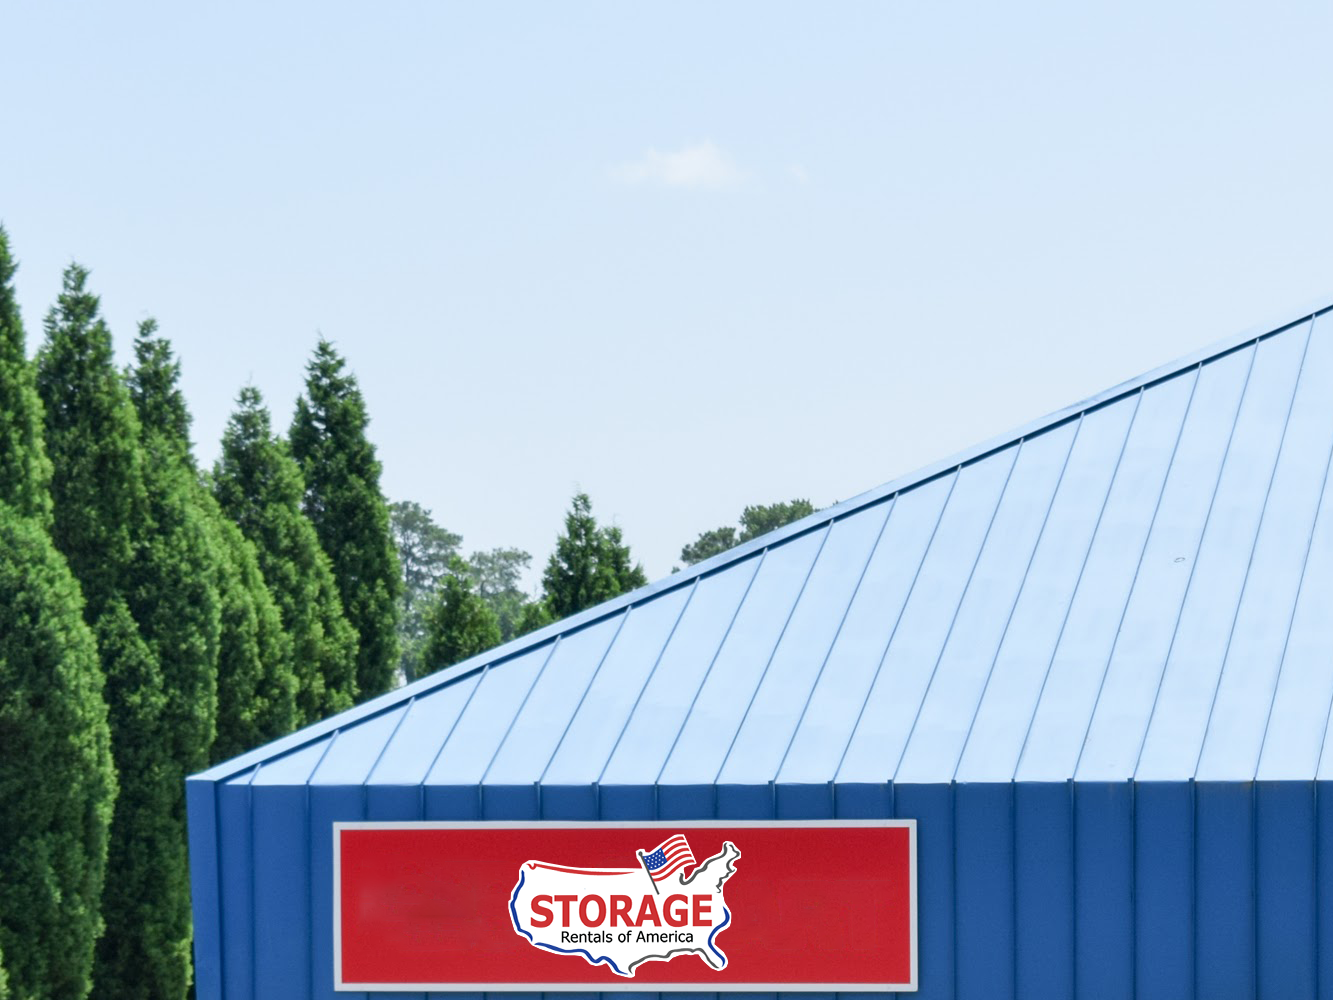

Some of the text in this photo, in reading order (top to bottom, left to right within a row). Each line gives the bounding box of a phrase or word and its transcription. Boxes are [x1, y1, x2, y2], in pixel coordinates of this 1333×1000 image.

[530, 893, 713, 928] STORAGE
[561, 930, 694, 943] Rentals of America
